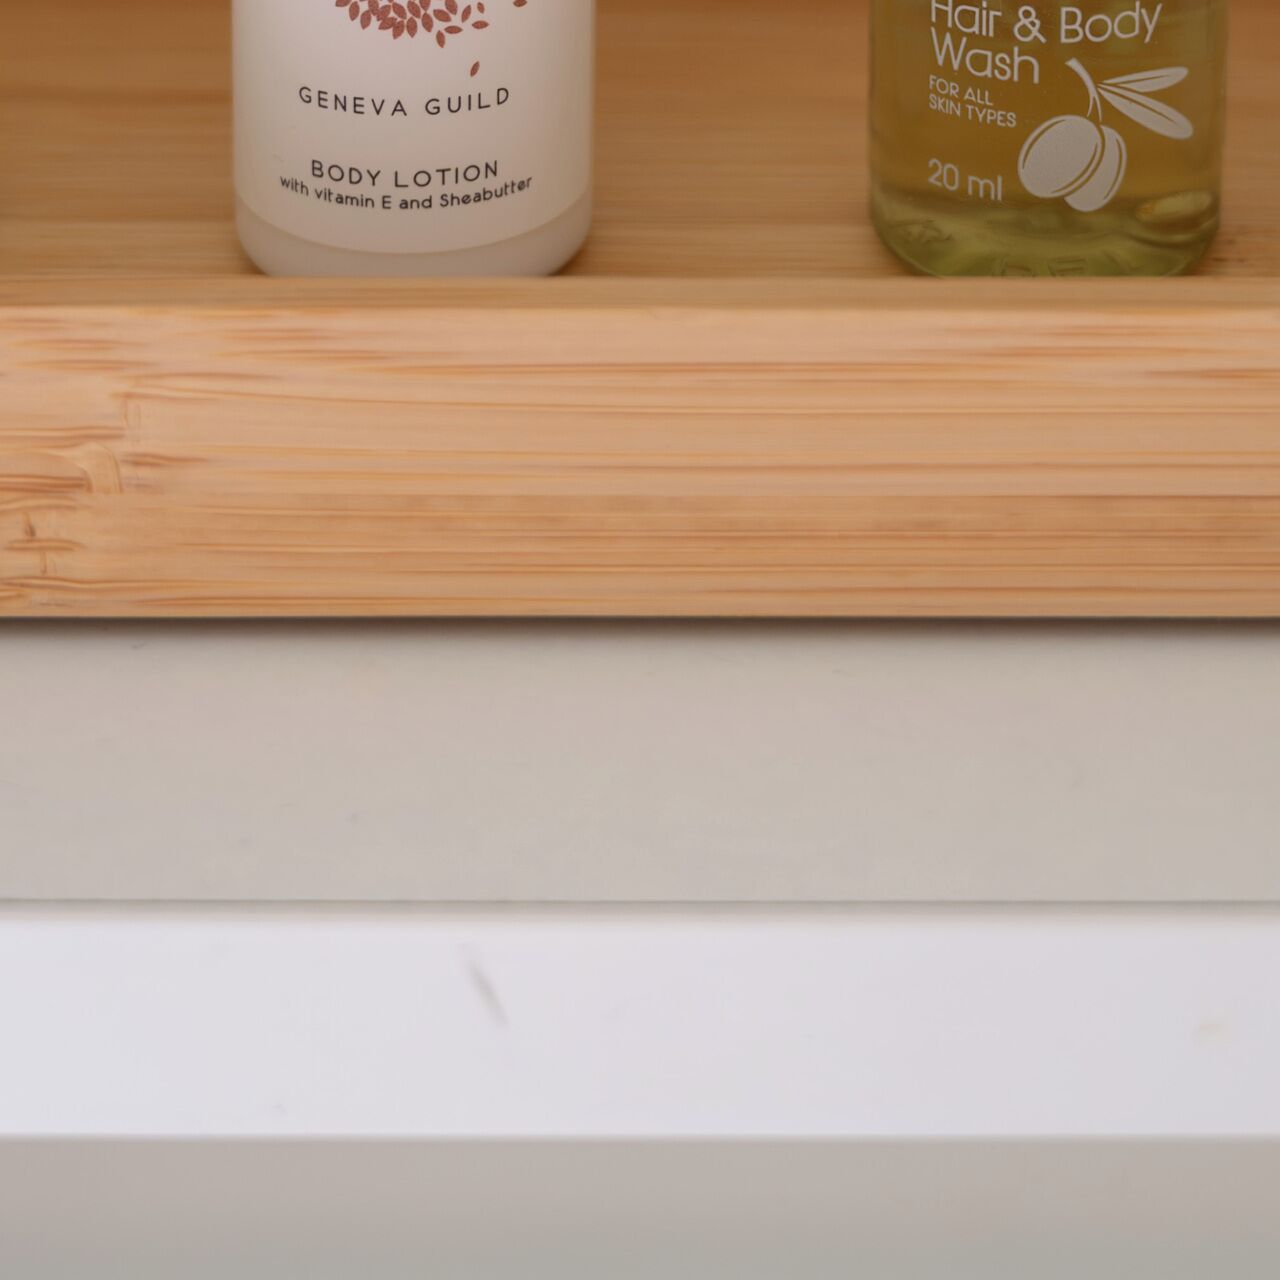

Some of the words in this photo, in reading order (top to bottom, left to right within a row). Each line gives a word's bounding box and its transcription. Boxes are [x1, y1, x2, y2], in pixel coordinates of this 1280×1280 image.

[1013, 5, 1046, 43] &
[1060, 1, 1162, 44] Body
[930, 27, 1039, 84] Wash
[299, 87, 408, 116] GENEVA
[425, 88, 510, 115] GUILD
[929, 75, 958, 98] FOR
[964, 86, 993, 105] ALL
[929, 94, 961, 117] SKIN
[965, 105, 1016, 128] TYPES
[312, 159, 381, 187] BODY
[394, 160, 498, 188] LOTION
[928, 158, 959, 190] 20
[968, 175, 1002, 201] ml
[280, 176, 309, 197] with
[315, 188, 375, 208] vitamin
[382, 196, 392, 209] E
[399, 196, 432, 210] and
[440, 176, 532, 208] Sheabutter
